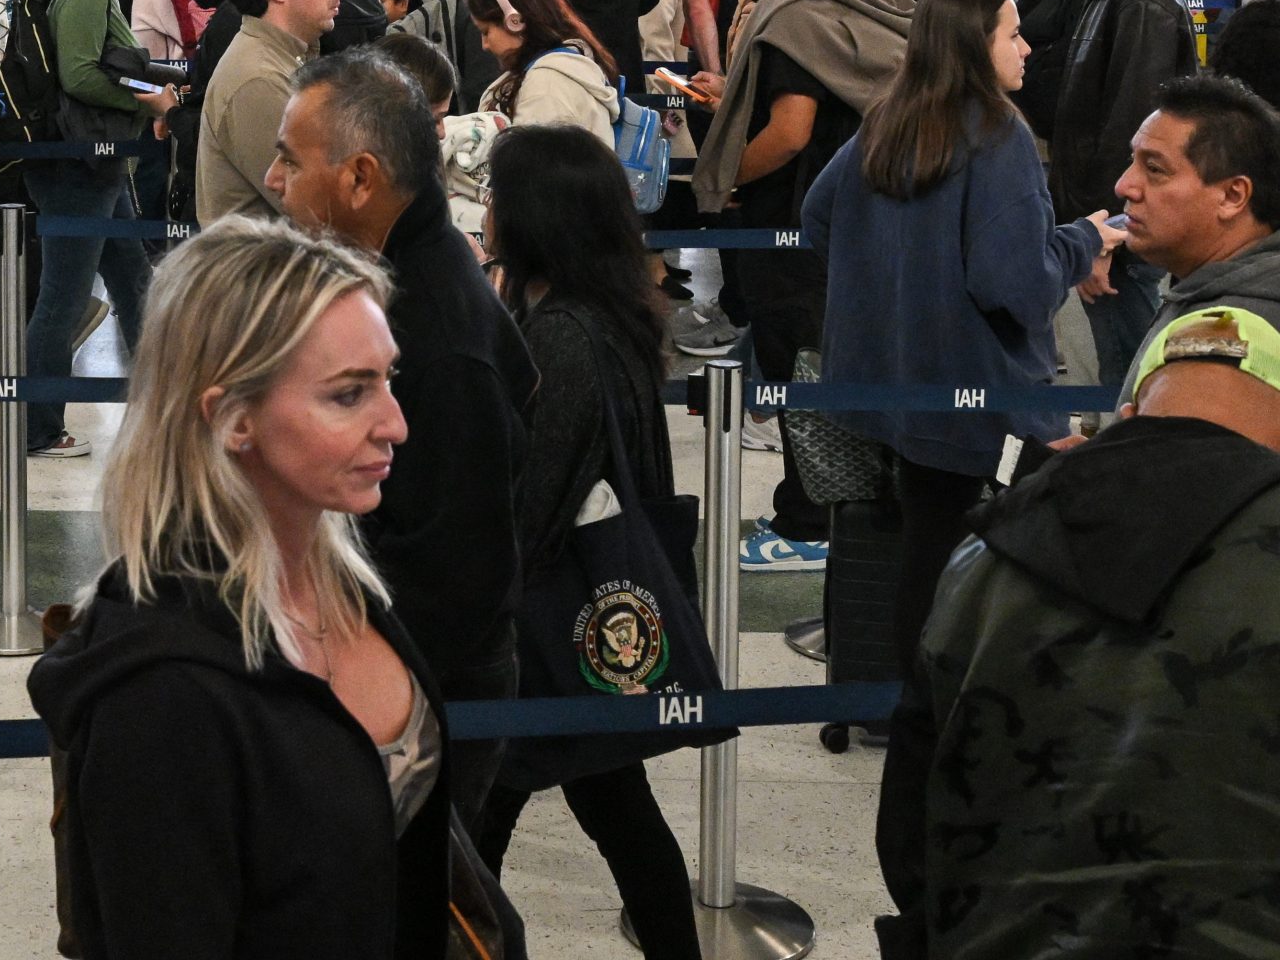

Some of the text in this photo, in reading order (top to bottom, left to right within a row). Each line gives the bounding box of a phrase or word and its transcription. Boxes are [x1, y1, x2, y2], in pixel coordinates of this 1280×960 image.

[1188, 0, 1204, 8] IAH
[1194, 24, 1205, 33] AH
[667, 96, 684, 108] IAH
[95, 143, 114, 155] IAH
[166, 224, 190, 238] IAH
[776, 231, 800, 246] IAH
[755, 385, 786, 405] IAH
[954, 388, 985, 408] IAH
[573, 603, 594, 642] UNITED
[595, 580, 621, 599] ATES
[659, 695, 703, 725] IAH
